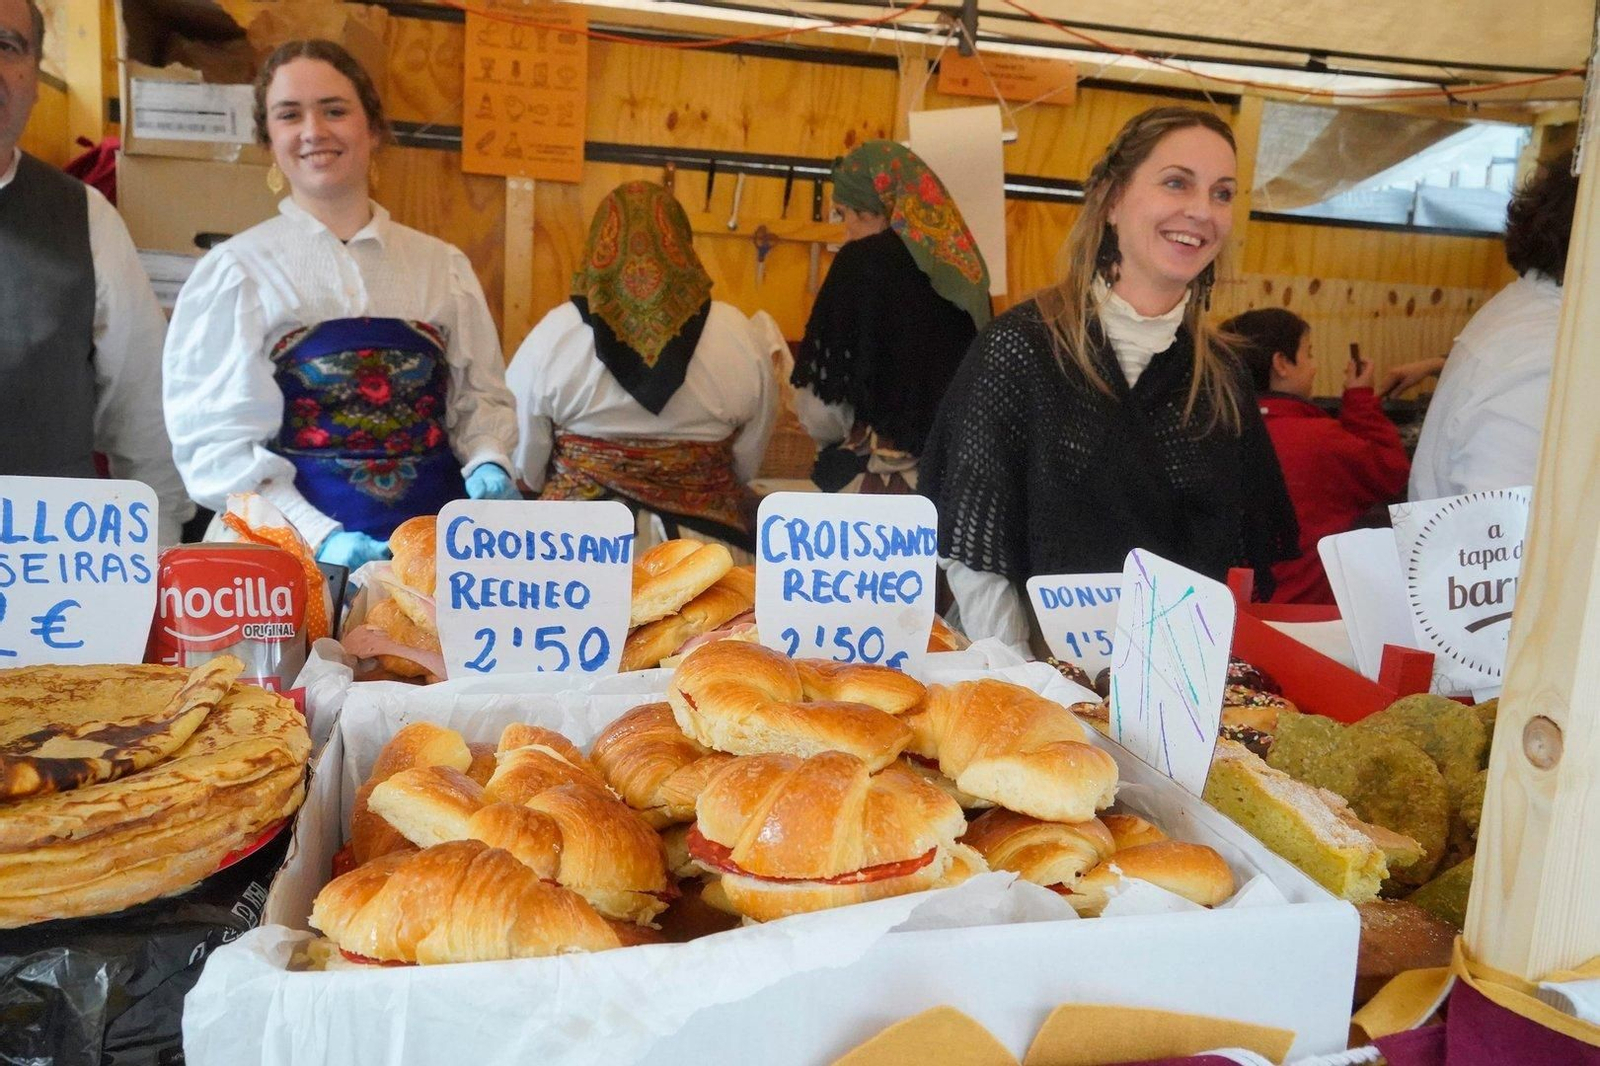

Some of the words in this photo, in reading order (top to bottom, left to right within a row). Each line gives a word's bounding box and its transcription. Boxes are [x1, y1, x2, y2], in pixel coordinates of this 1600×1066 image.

[0, 498, 150, 546] LLOAS
[446, 516, 635, 564] CROISSANT
[1488, 524, 1504, 539] a
[1459, 546, 1511, 570] tapa
[160, 577, 293, 618] nocilla
[449, 571, 590, 610] RECHEO
[784, 568, 923, 604] RECHEO
[244, 624, 294, 637] ORIGINAL
